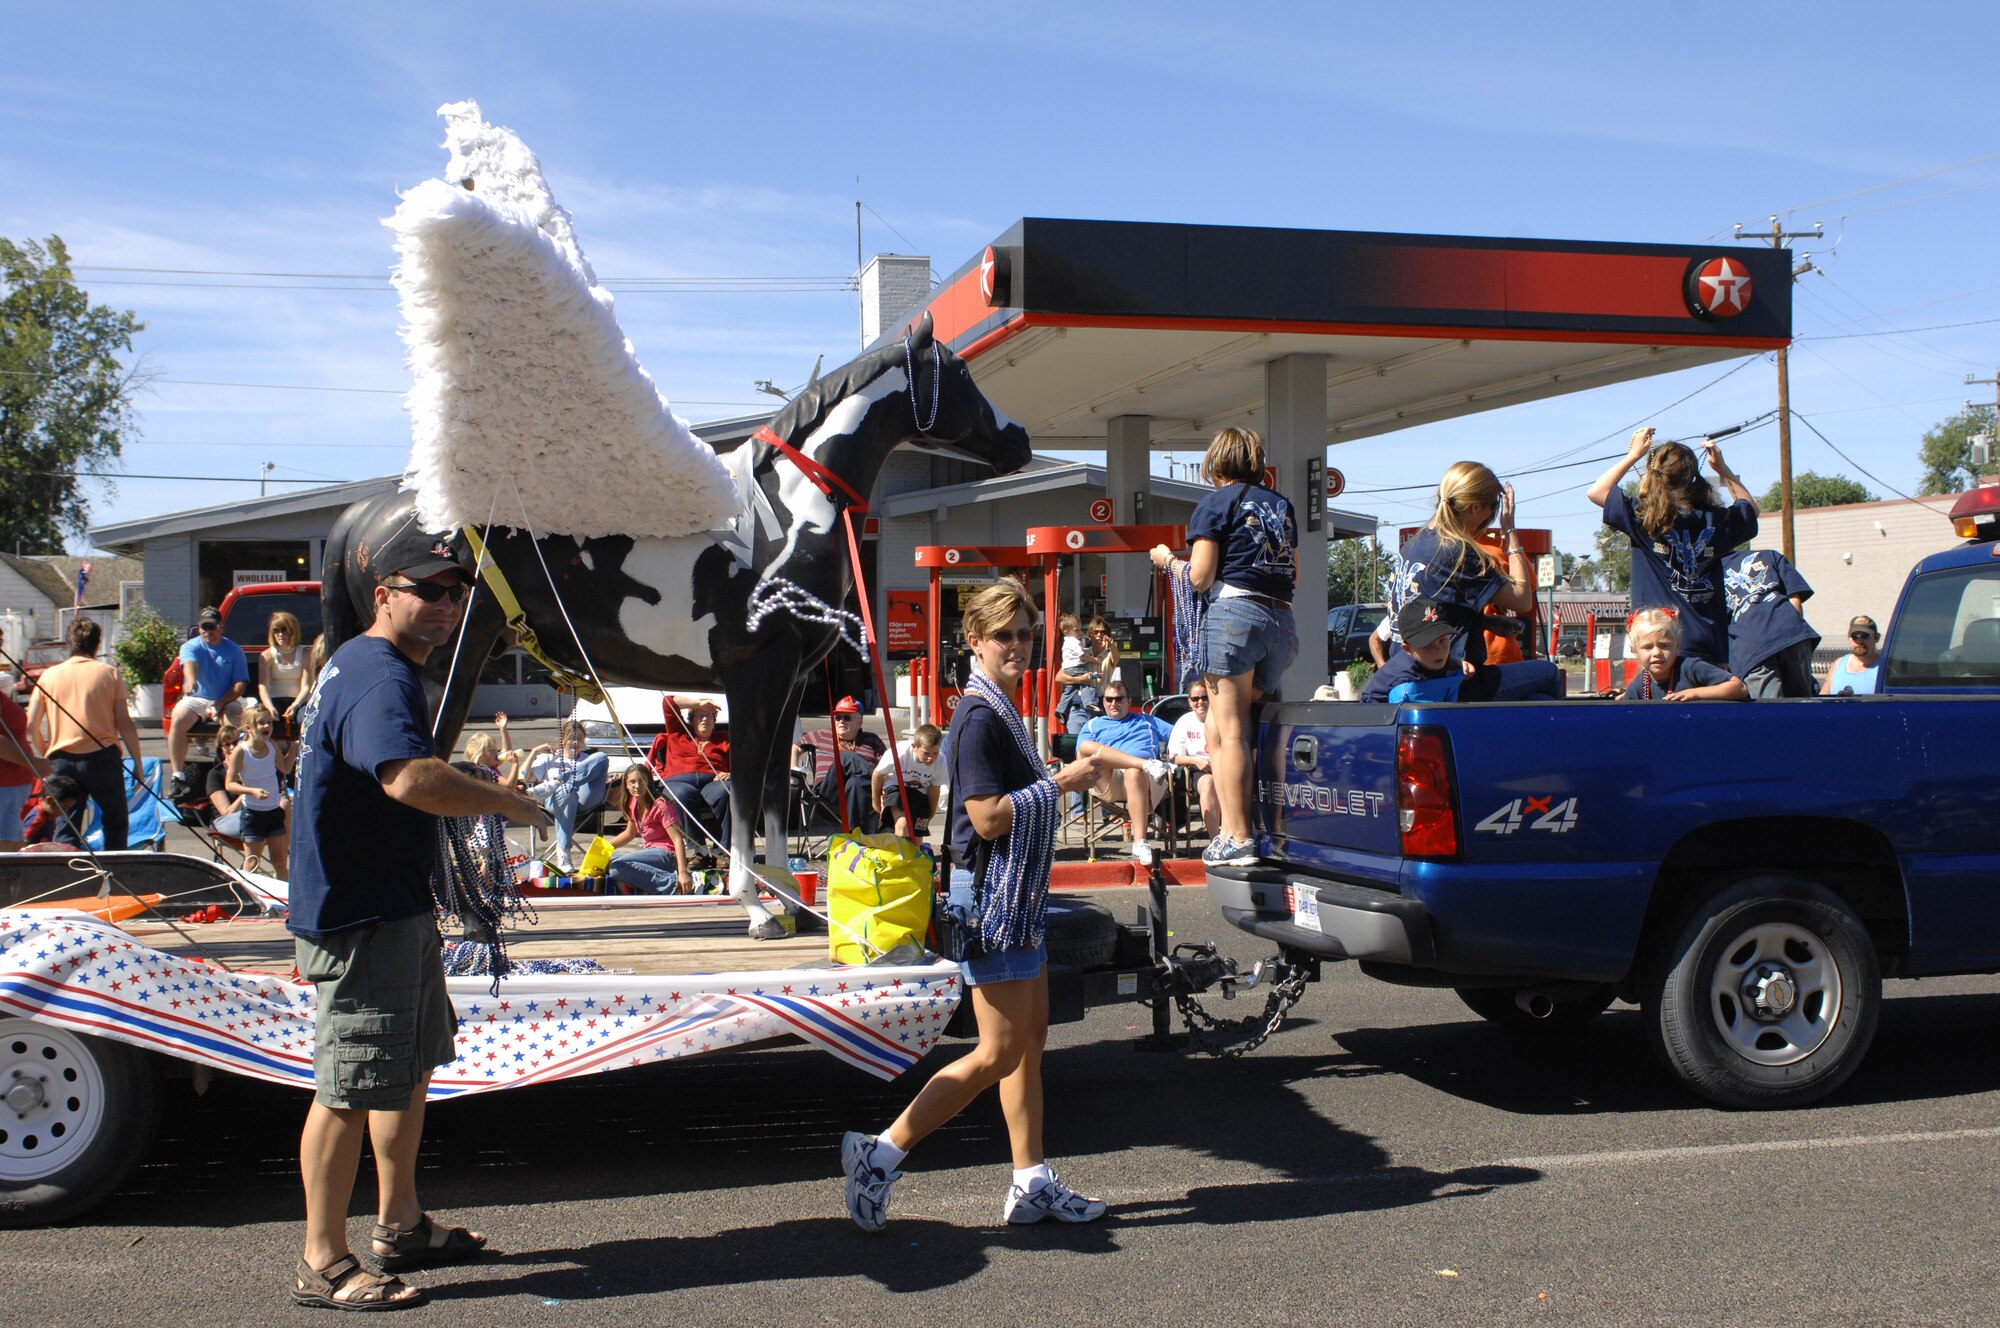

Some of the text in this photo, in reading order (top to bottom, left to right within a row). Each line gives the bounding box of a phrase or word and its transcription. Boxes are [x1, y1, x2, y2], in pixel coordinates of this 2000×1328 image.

[1327, 475, 1336, 489] 6
[1096, 505, 1106, 517] 2
[1070, 534, 1079, 545] 4
[948, 552, 956, 561] 2
[237, 574, 283, 583] WHOLESALE
[1258, 780, 1384, 818] HEVROLET
